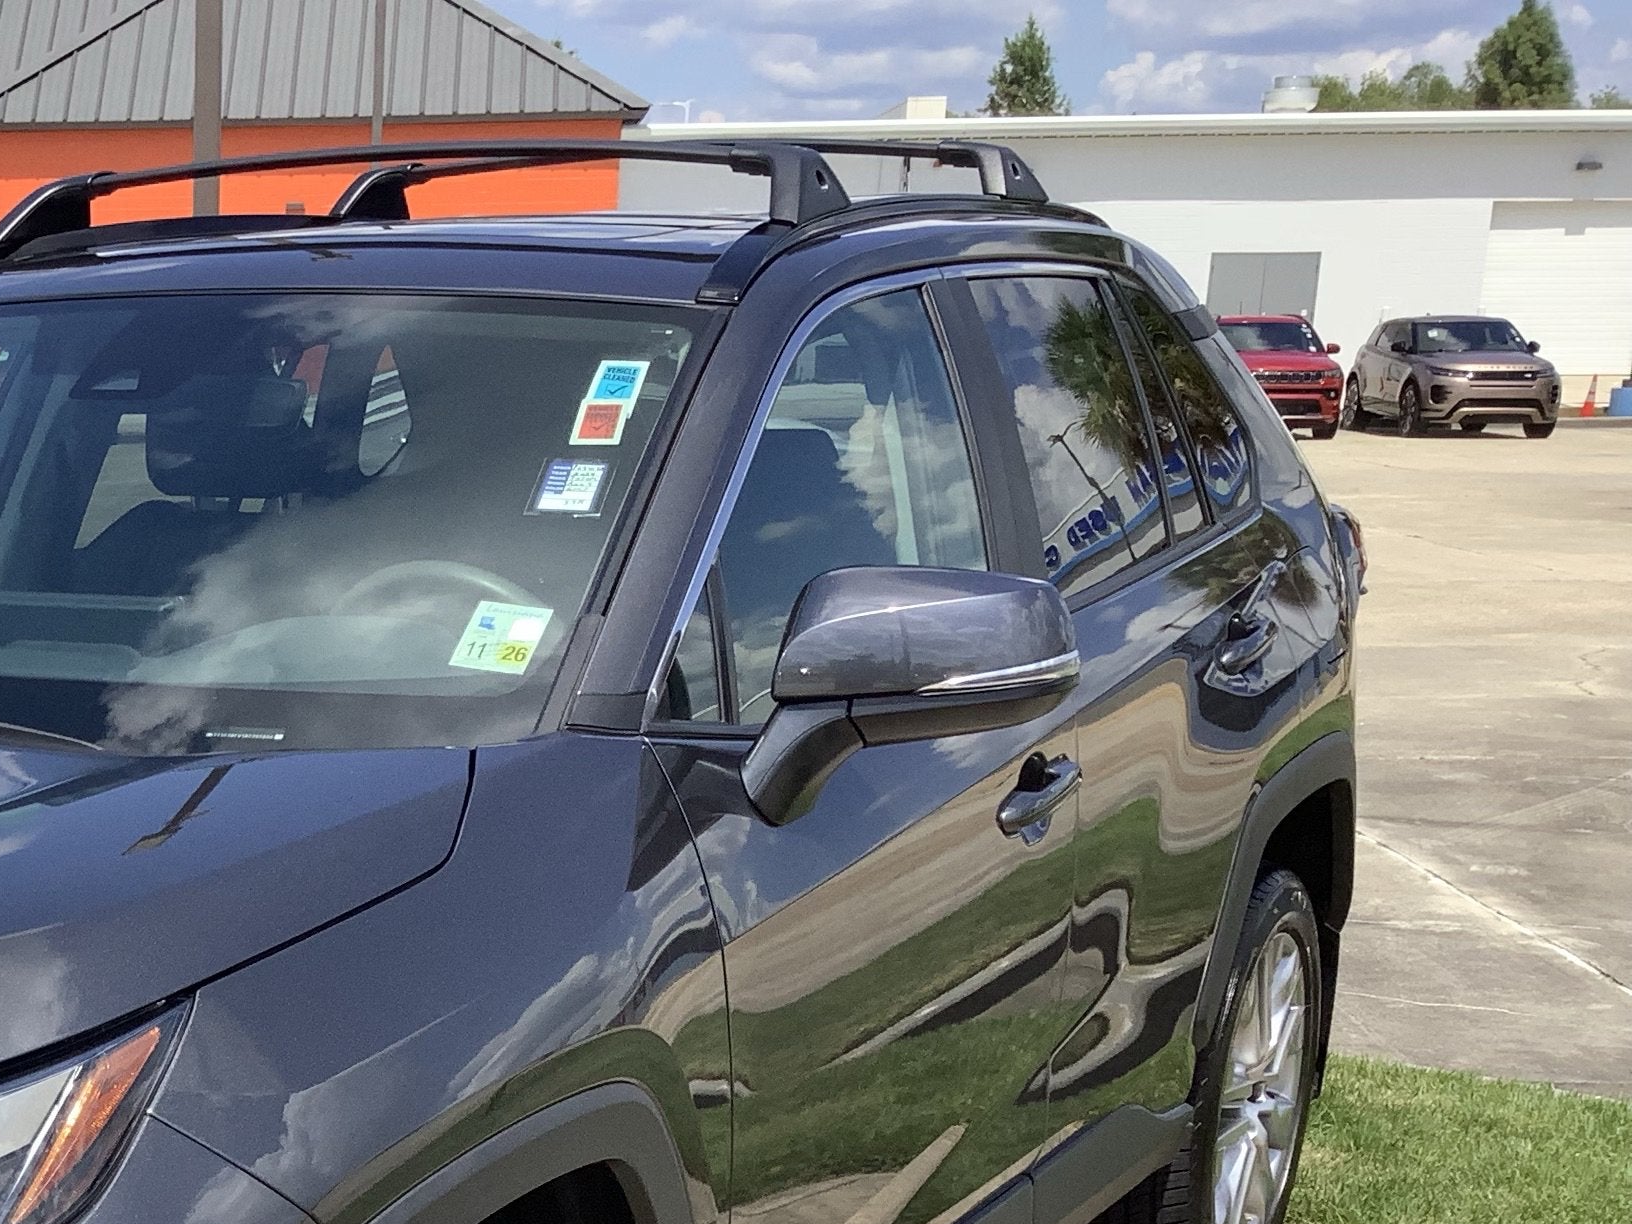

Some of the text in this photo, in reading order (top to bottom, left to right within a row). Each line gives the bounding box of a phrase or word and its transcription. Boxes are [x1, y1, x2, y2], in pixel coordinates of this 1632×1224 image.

[606, 367, 639, 375] VEHICLE
[602, 373, 636, 384] CLEANED
[467, 641, 488, 659] 11
[502, 645, 528, 662] 26
